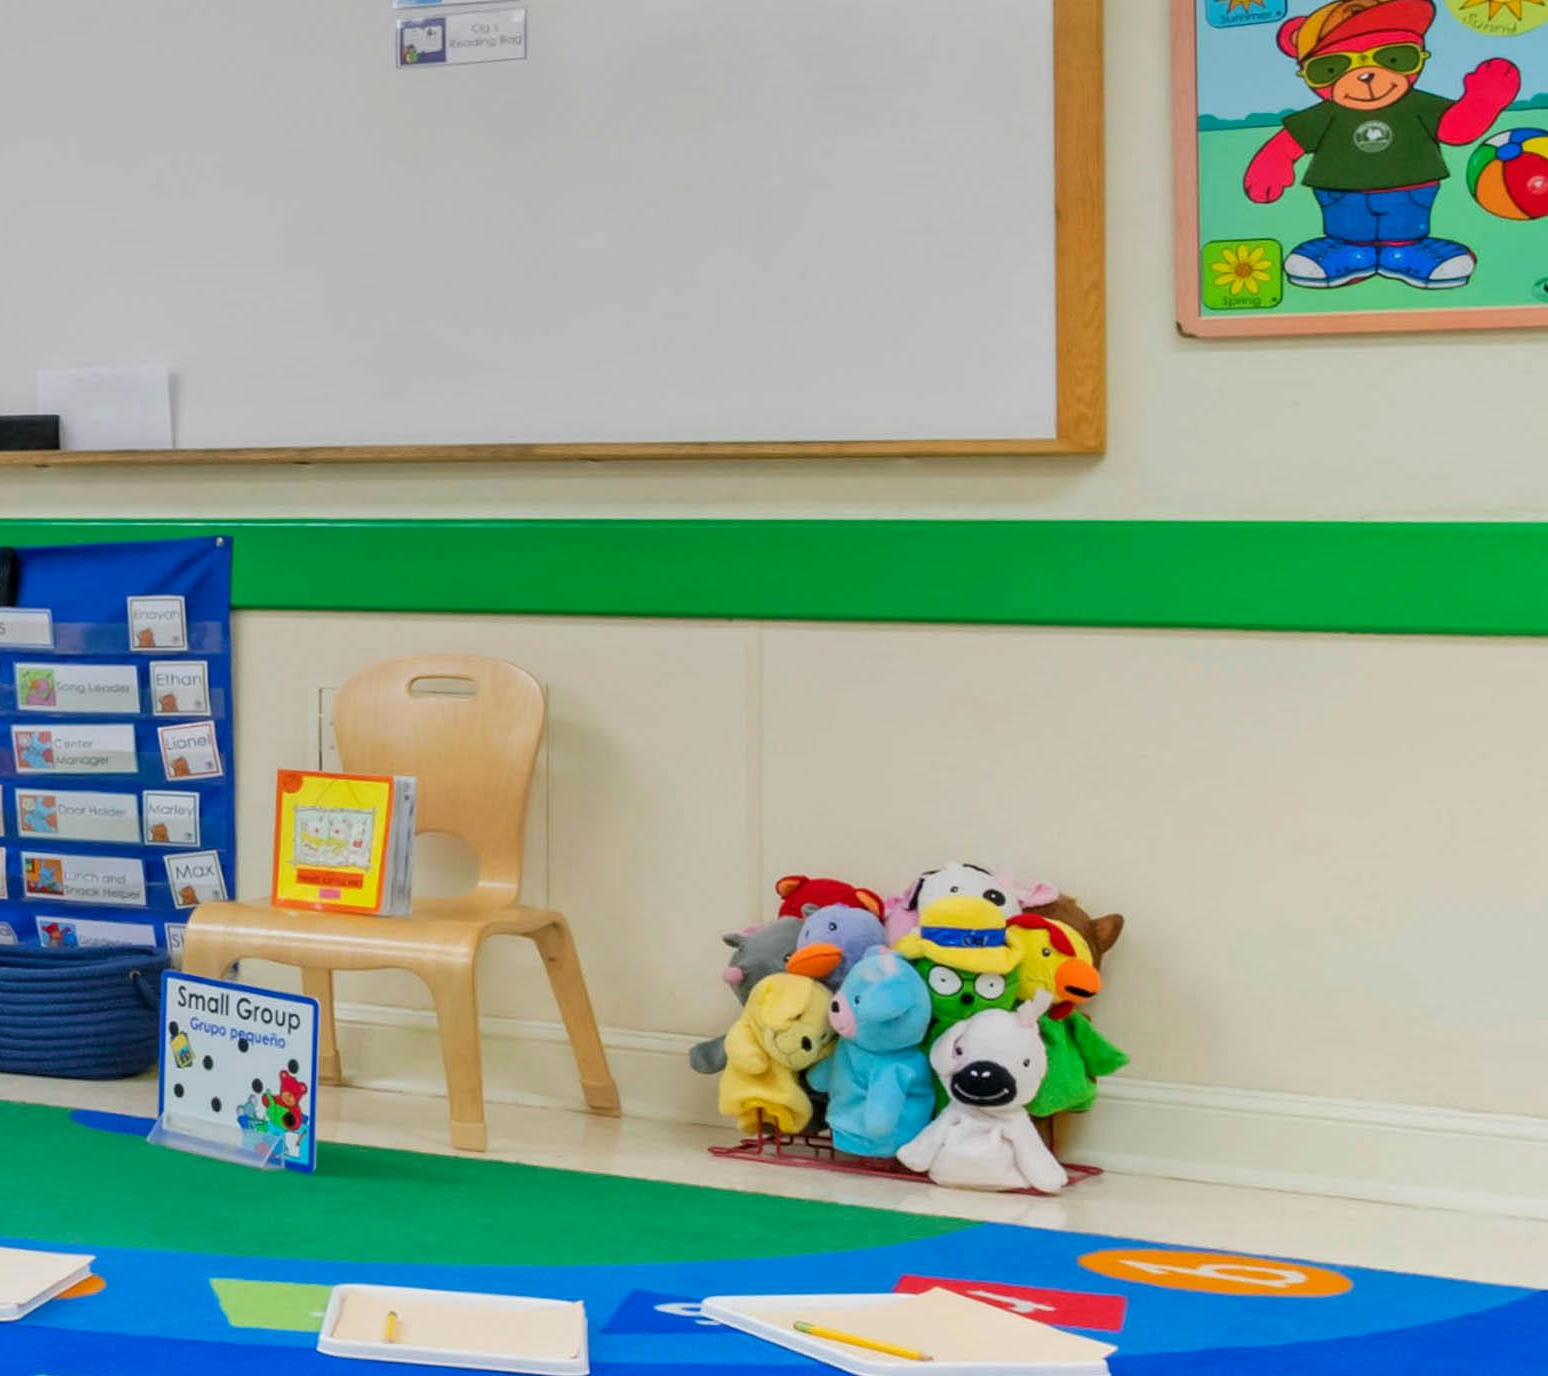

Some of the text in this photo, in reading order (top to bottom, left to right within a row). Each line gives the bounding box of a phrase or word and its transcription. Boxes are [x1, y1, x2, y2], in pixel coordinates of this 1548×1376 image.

[1220, 10, 1273, 24] Summer
[1462, 13, 1517, 34] Sunny
[1222, 294, 1262, 308] Spring
[156, 672, 202, 687] Ethan
[88, 682, 130, 694] Leader
[55, 738, 93, 749] Center
[166, 733, 211, 751] Lionel
[56, 755, 109, 767] Manager
[58, 805, 85, 815] Door
[148, 803, 193, 816] Marley
[175, 863, 215, 880] Max
[64, 873, 126, 885] Lunch and
[64, 885, 140, 900] Snack Helper
[177, 986, 301, 1033] Small Group
[189, 1016, 286, 1051] Grupo pequeño
